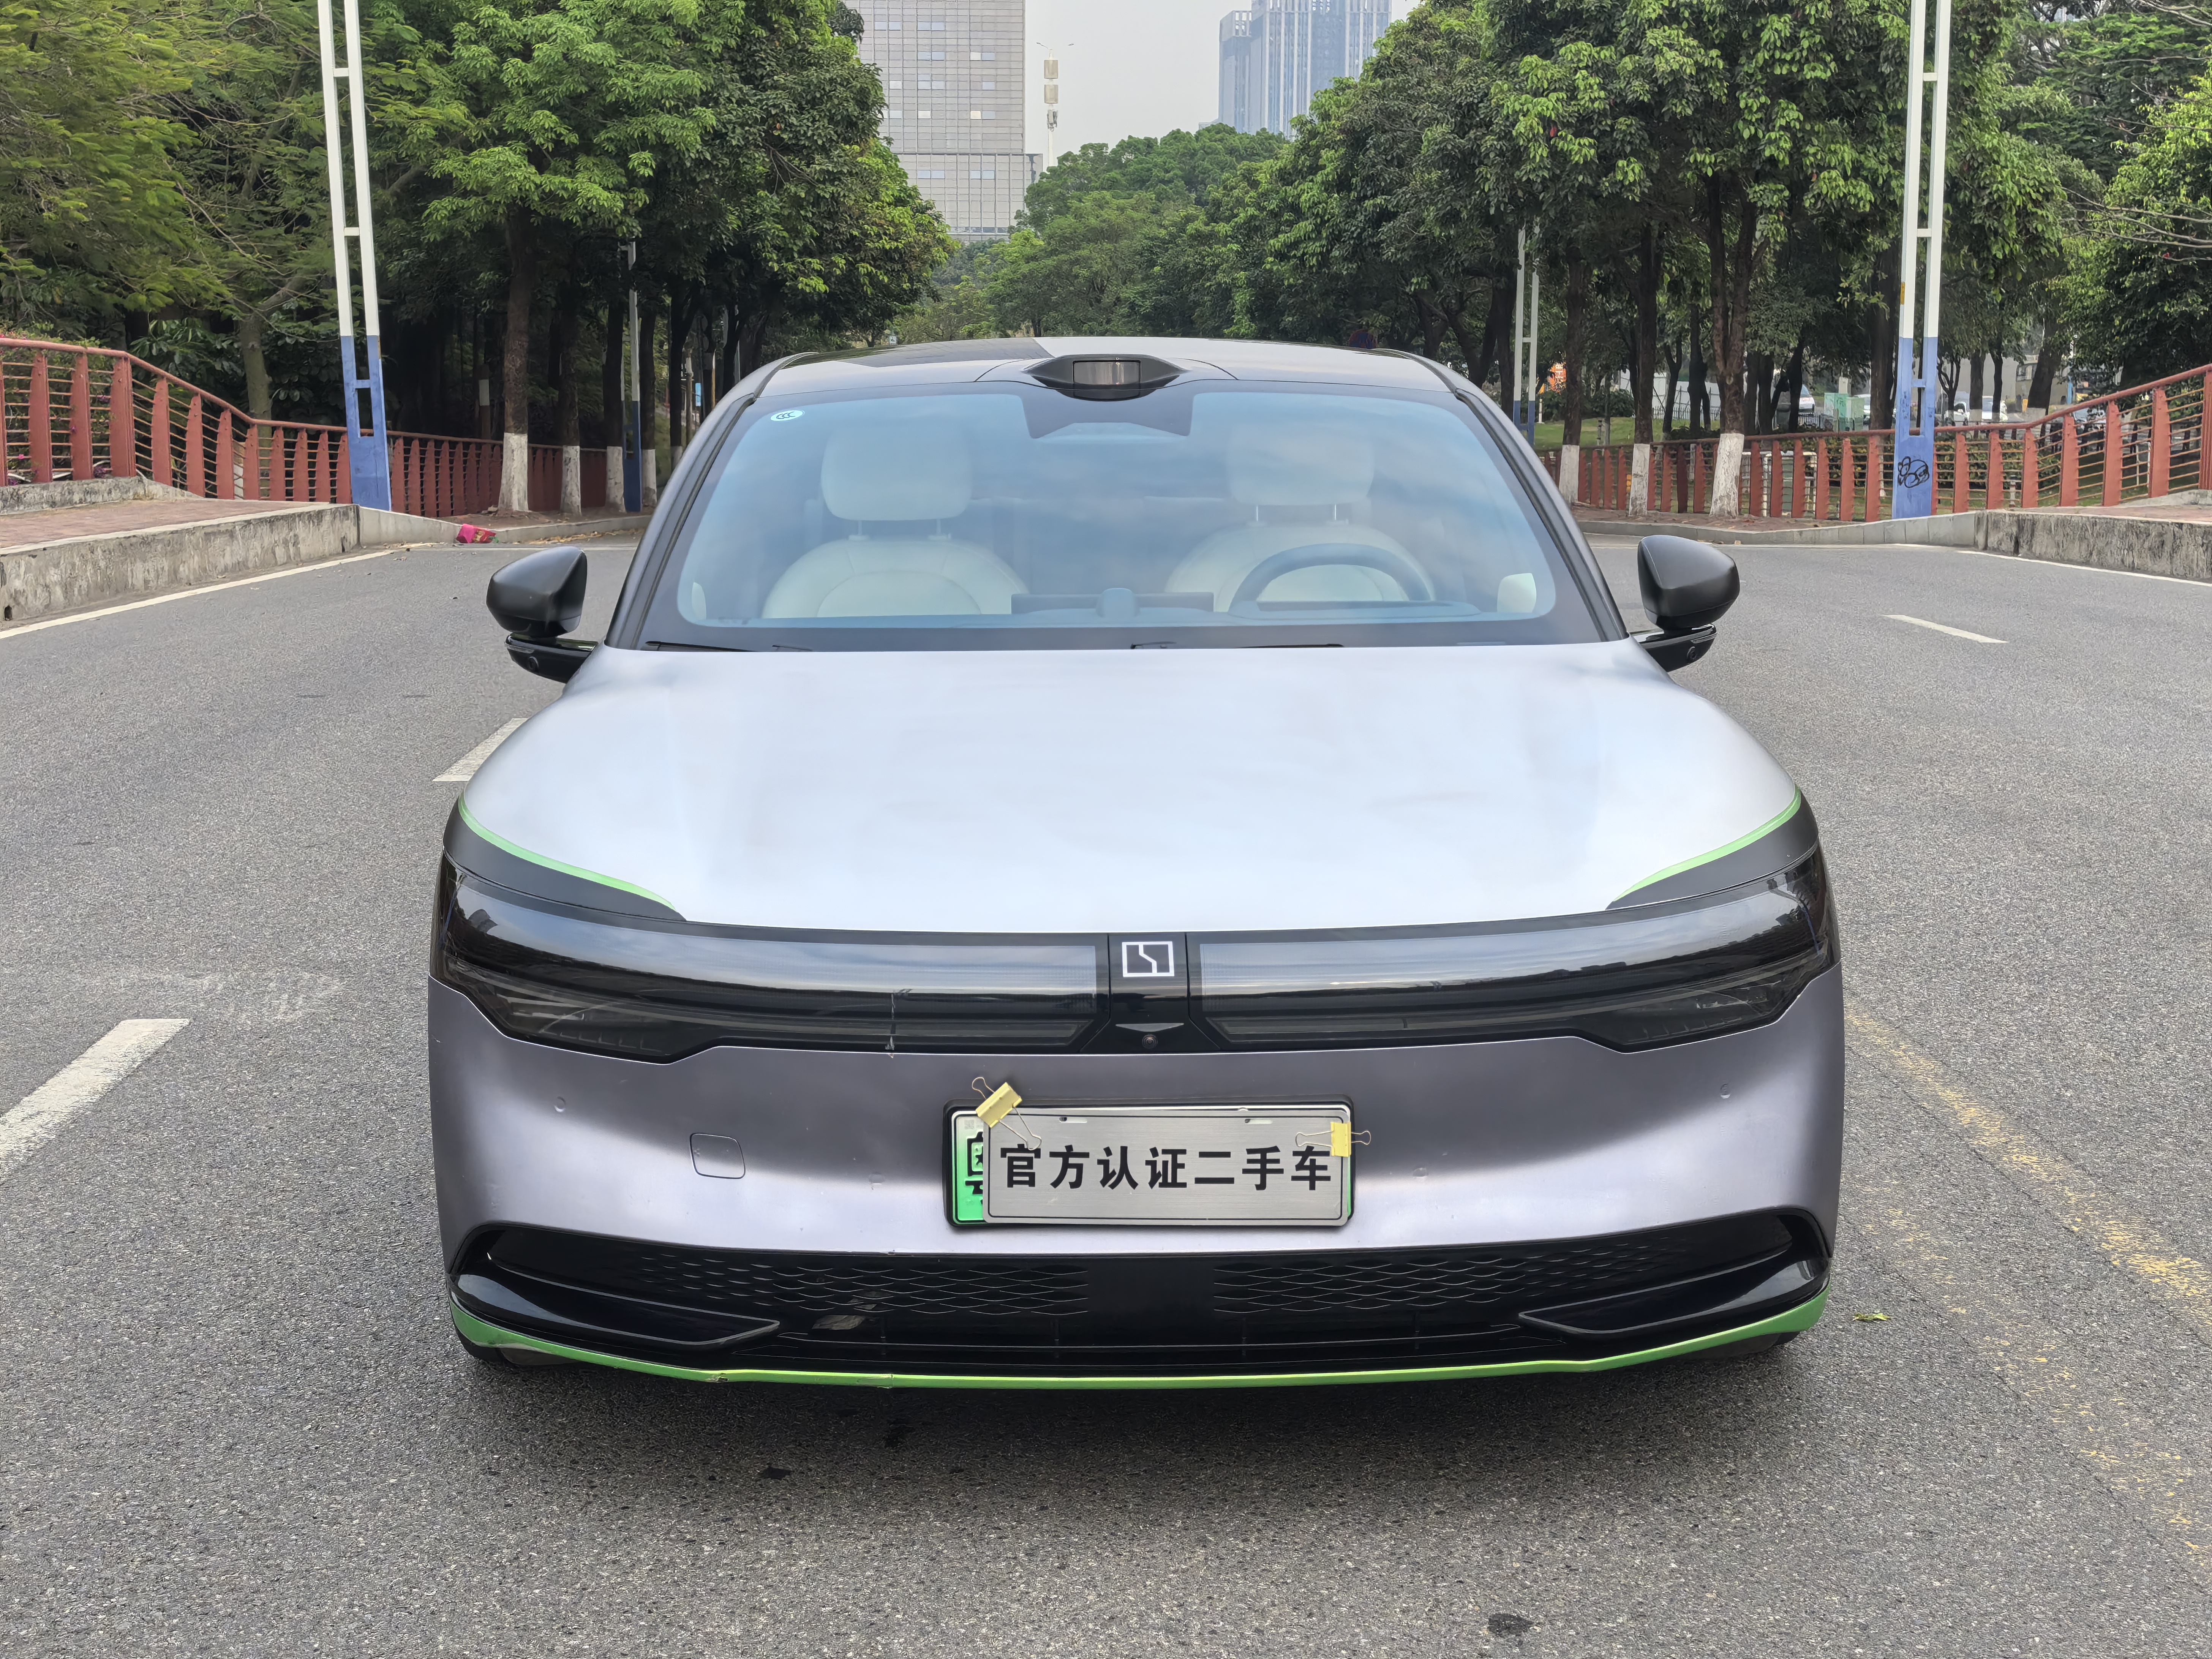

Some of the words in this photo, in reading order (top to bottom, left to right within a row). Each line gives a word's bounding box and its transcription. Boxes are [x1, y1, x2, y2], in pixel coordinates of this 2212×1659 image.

[1000, 1143, 1331, 1191] 官方认证二手车
